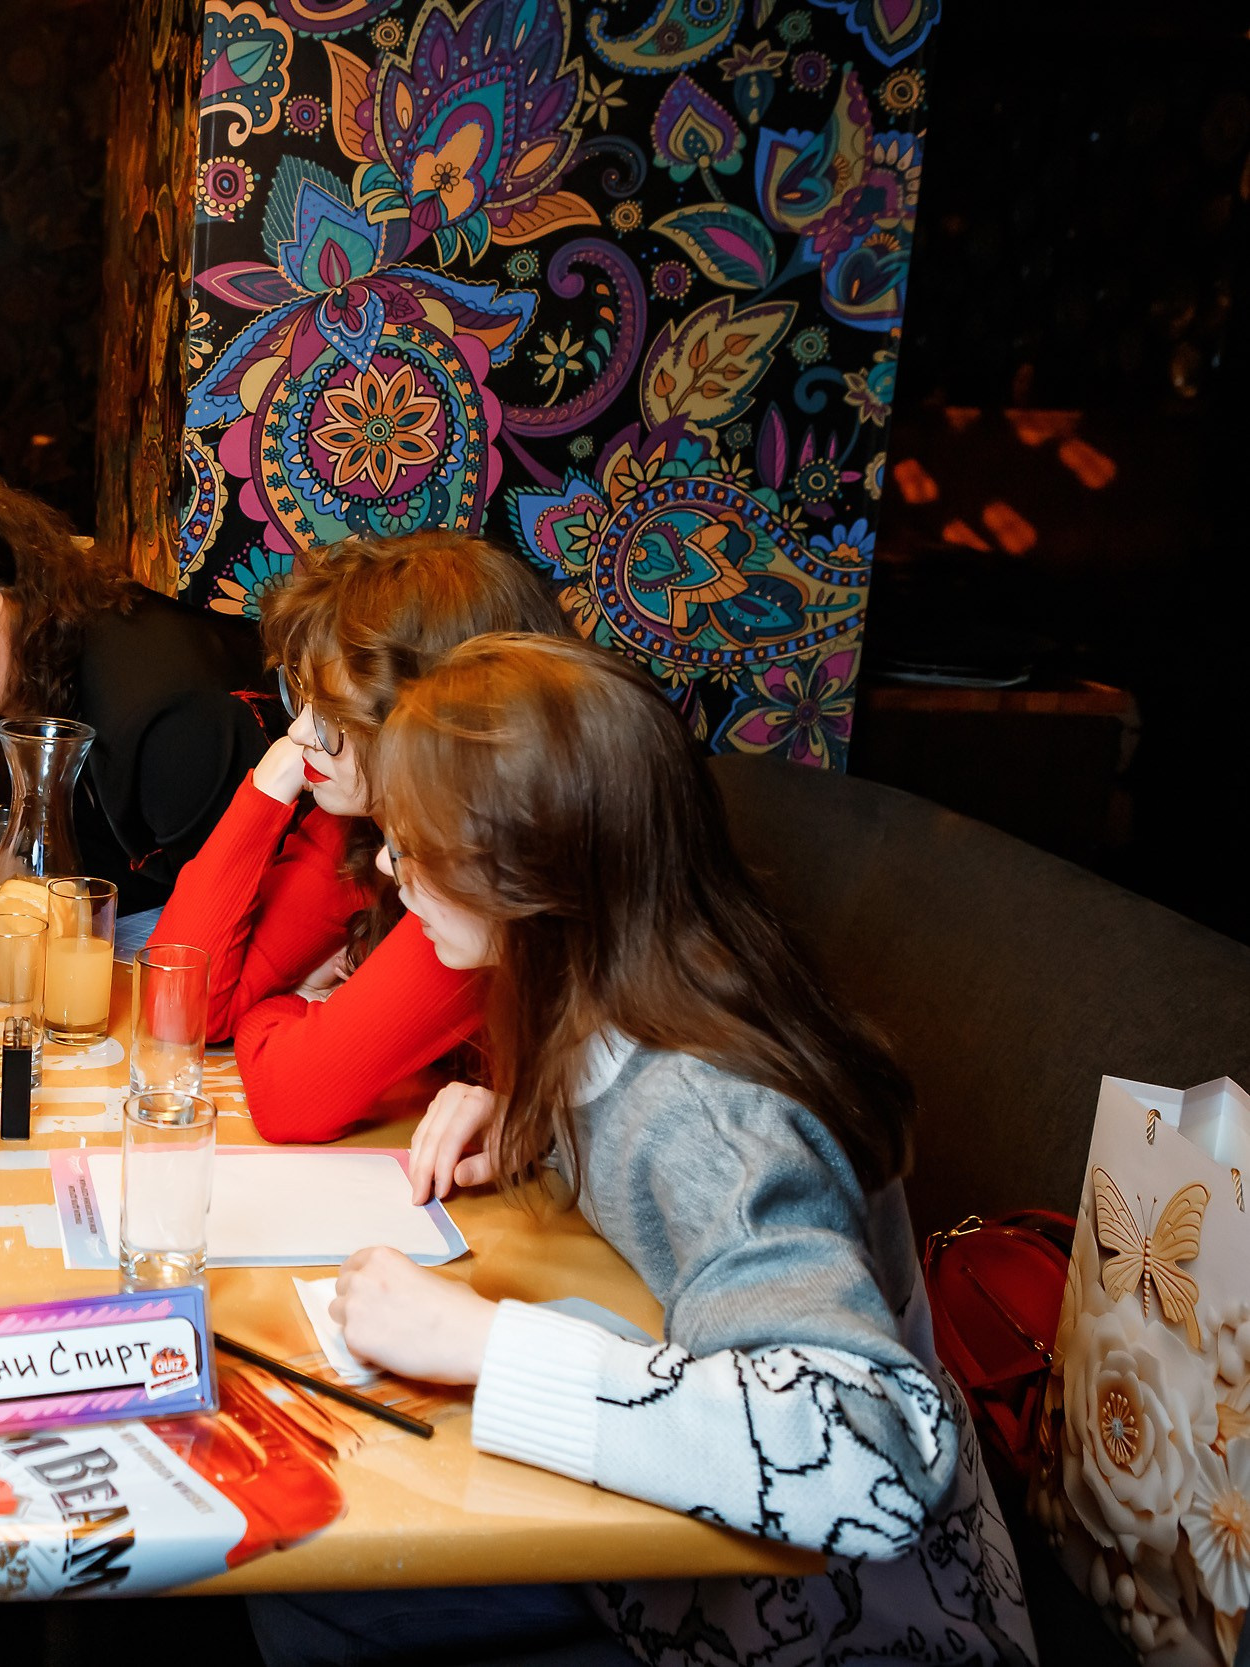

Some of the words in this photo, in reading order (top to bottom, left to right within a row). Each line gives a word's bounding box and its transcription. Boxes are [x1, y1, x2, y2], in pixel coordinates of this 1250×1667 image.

[49, 1340, 151, 1375] Спирт
[154, 1357, 184, 1375] QUIZ
[26, 1446, 136, 1597] BEAM
